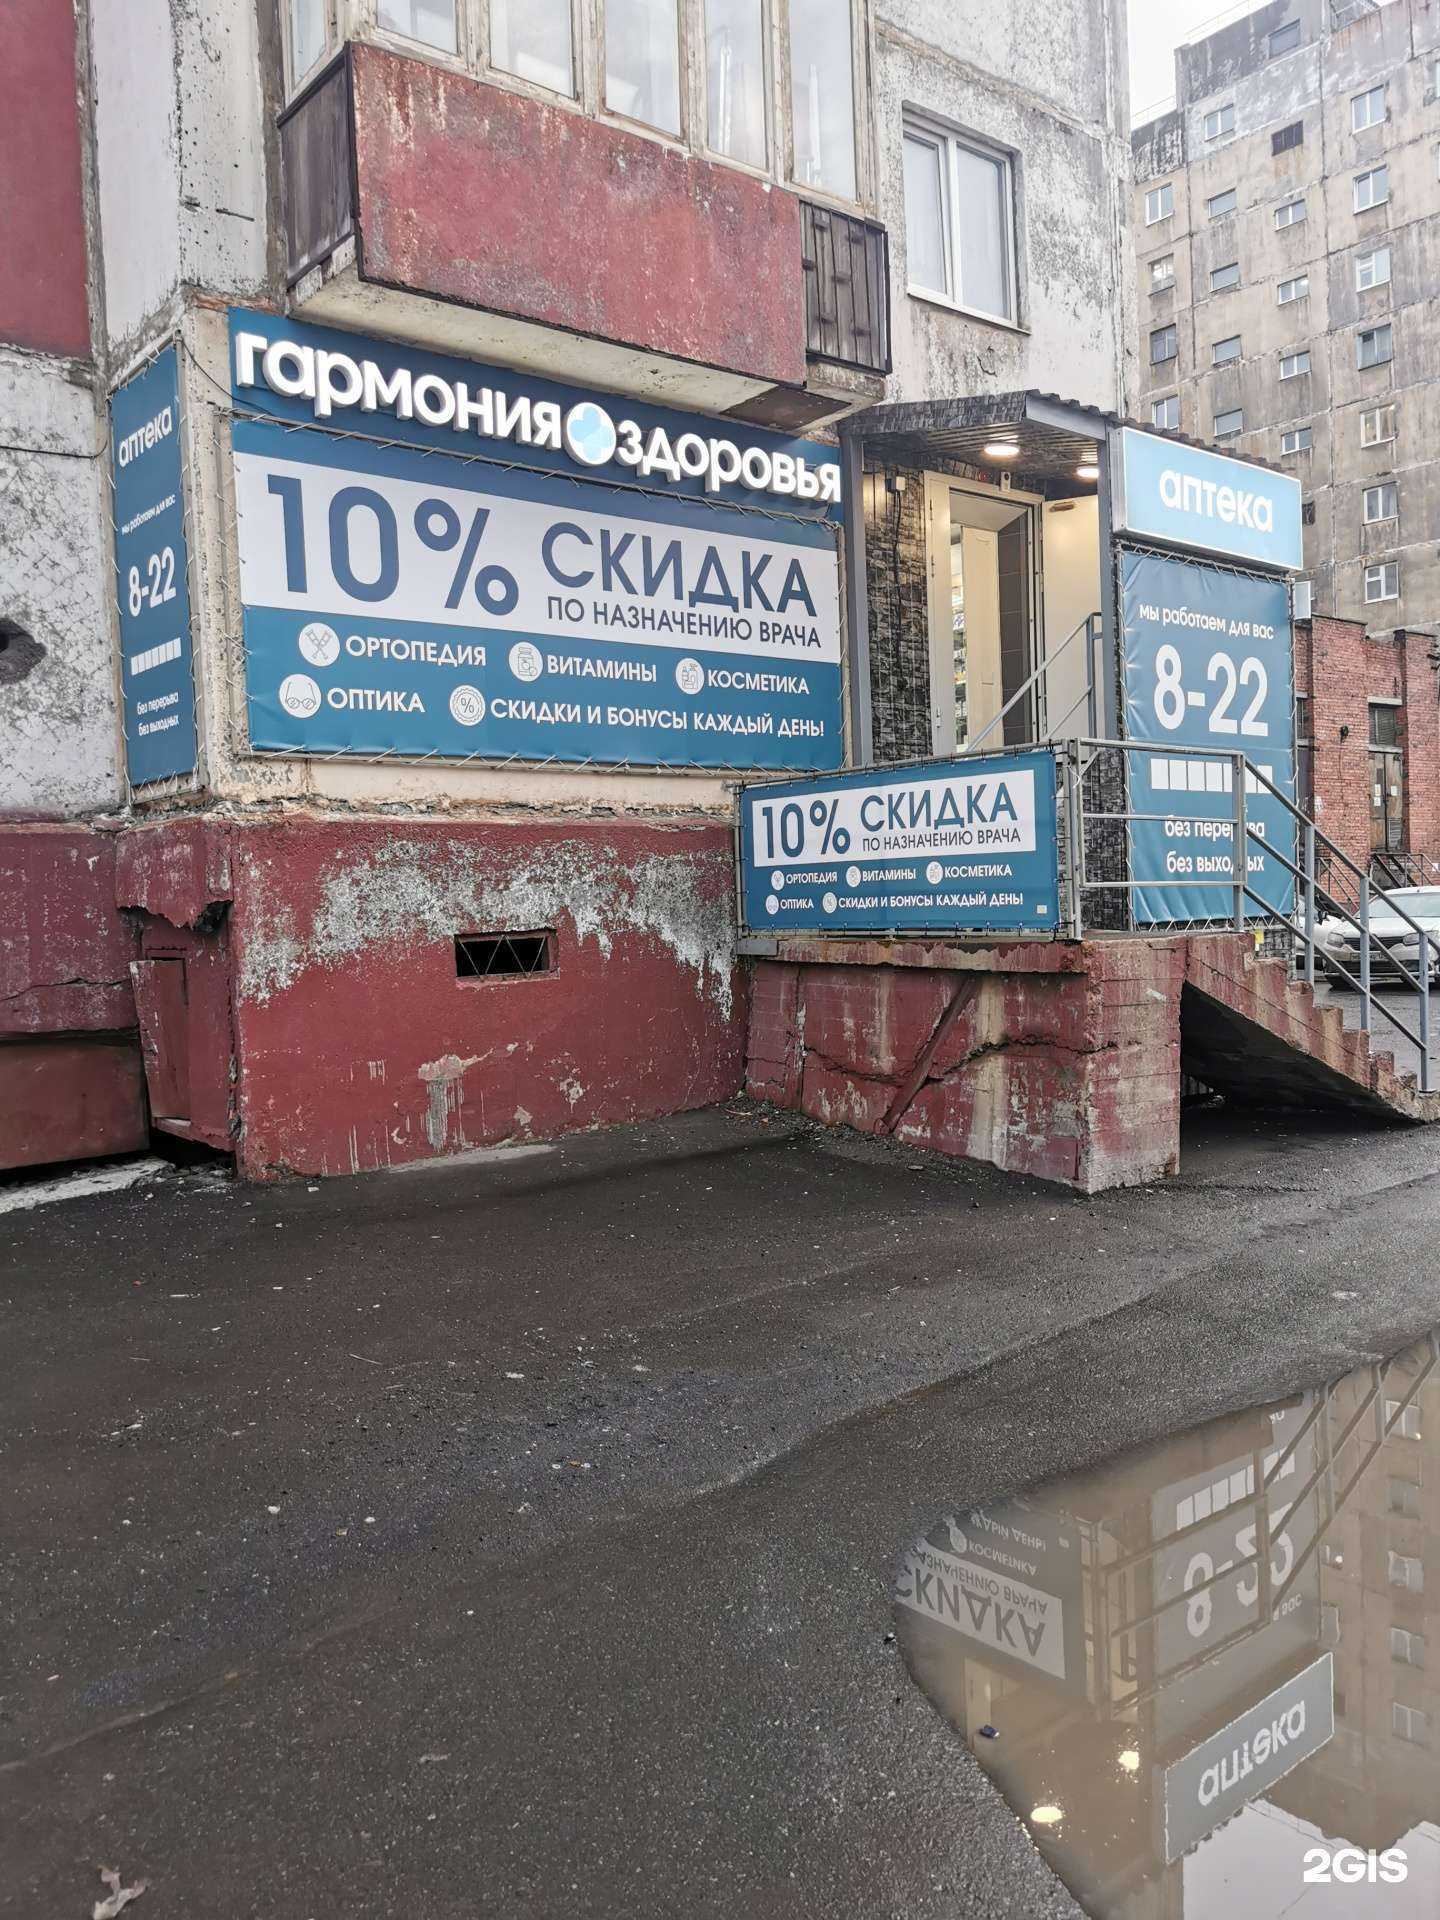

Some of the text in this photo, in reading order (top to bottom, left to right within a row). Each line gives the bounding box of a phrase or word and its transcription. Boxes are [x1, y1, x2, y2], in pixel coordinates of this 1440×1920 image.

[118, 406, 173, 468] аптека
[235, 332, 842, 503] гармония здоровья
[1158, 469, 1273, 533] аптека
[267, 473, 818, 617] 10% СКИДКА
[128, 546, 177, 617] 8-22
[547, 596, 822, 648] ПО НАЗНАЧЕНИЮ ВРАЧА
[1139, 604, 1275, 640] мы работаем для вас
[345, 635, 810, 695] ОРТОПЕДИЯ ВИТАМИНЫ КОСМЕТИКА
[1154, 644, 1269, 736] 8-22
[327, 687, 825, 738] ОПТИКА СКИДКИ И БОНУСЫ КАЖДЫЙ ДЕНЬ!
[762, 782, 1018, 858] 10% СКИДКА
[863, 827, 1021, 852] ПО НАЗНАЧЕНИЮ ВРАЧА
[1165, 815, 1265, 842] без перева
[785, 864, 1013, 884] ОРТОПЕДИЯ ВИТАМИНЫ КОСМЕТИКА
[1166, 850, 1265, 875] без выхоых
[780, 891, 1024, 910] ОПТИКА СКИДКИ И БОНУСЫ КАЖДЫЙ ДЕНЬ!
